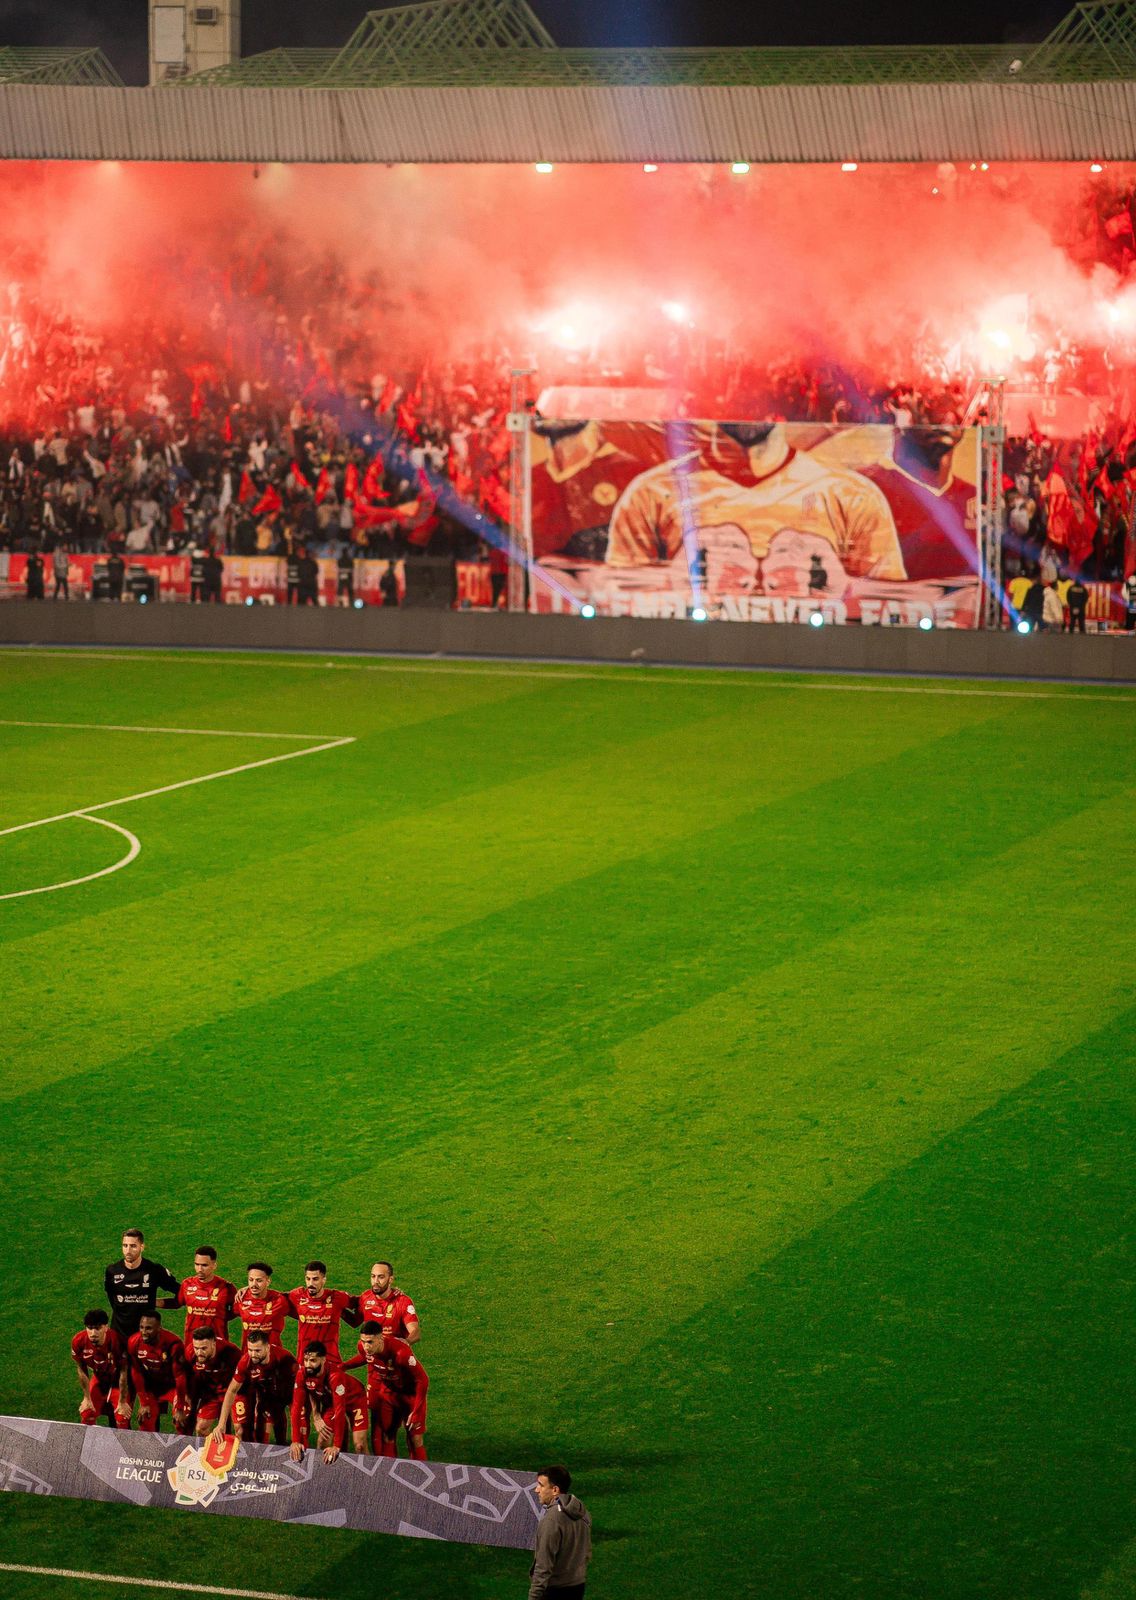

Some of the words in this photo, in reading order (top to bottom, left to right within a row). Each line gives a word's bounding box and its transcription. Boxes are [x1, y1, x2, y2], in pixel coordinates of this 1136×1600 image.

[859, 600, 957, 630] FADE
[235, 1401, 246, 1416] 8
[352, 1408, 364, 1421] 2
[119, 1456, 143, 1466] ROSHN
[144, 1459, 165, 1468] SAUDI
[116, 1467, 163, 1483] LEAGUE
[187, 1469, 208, 1481] RSL
[232, 1467, 257, 1480] روشن
[257, 1472, 279, 1483] دوري
[230, 1482, 278, 1494] السعودي
